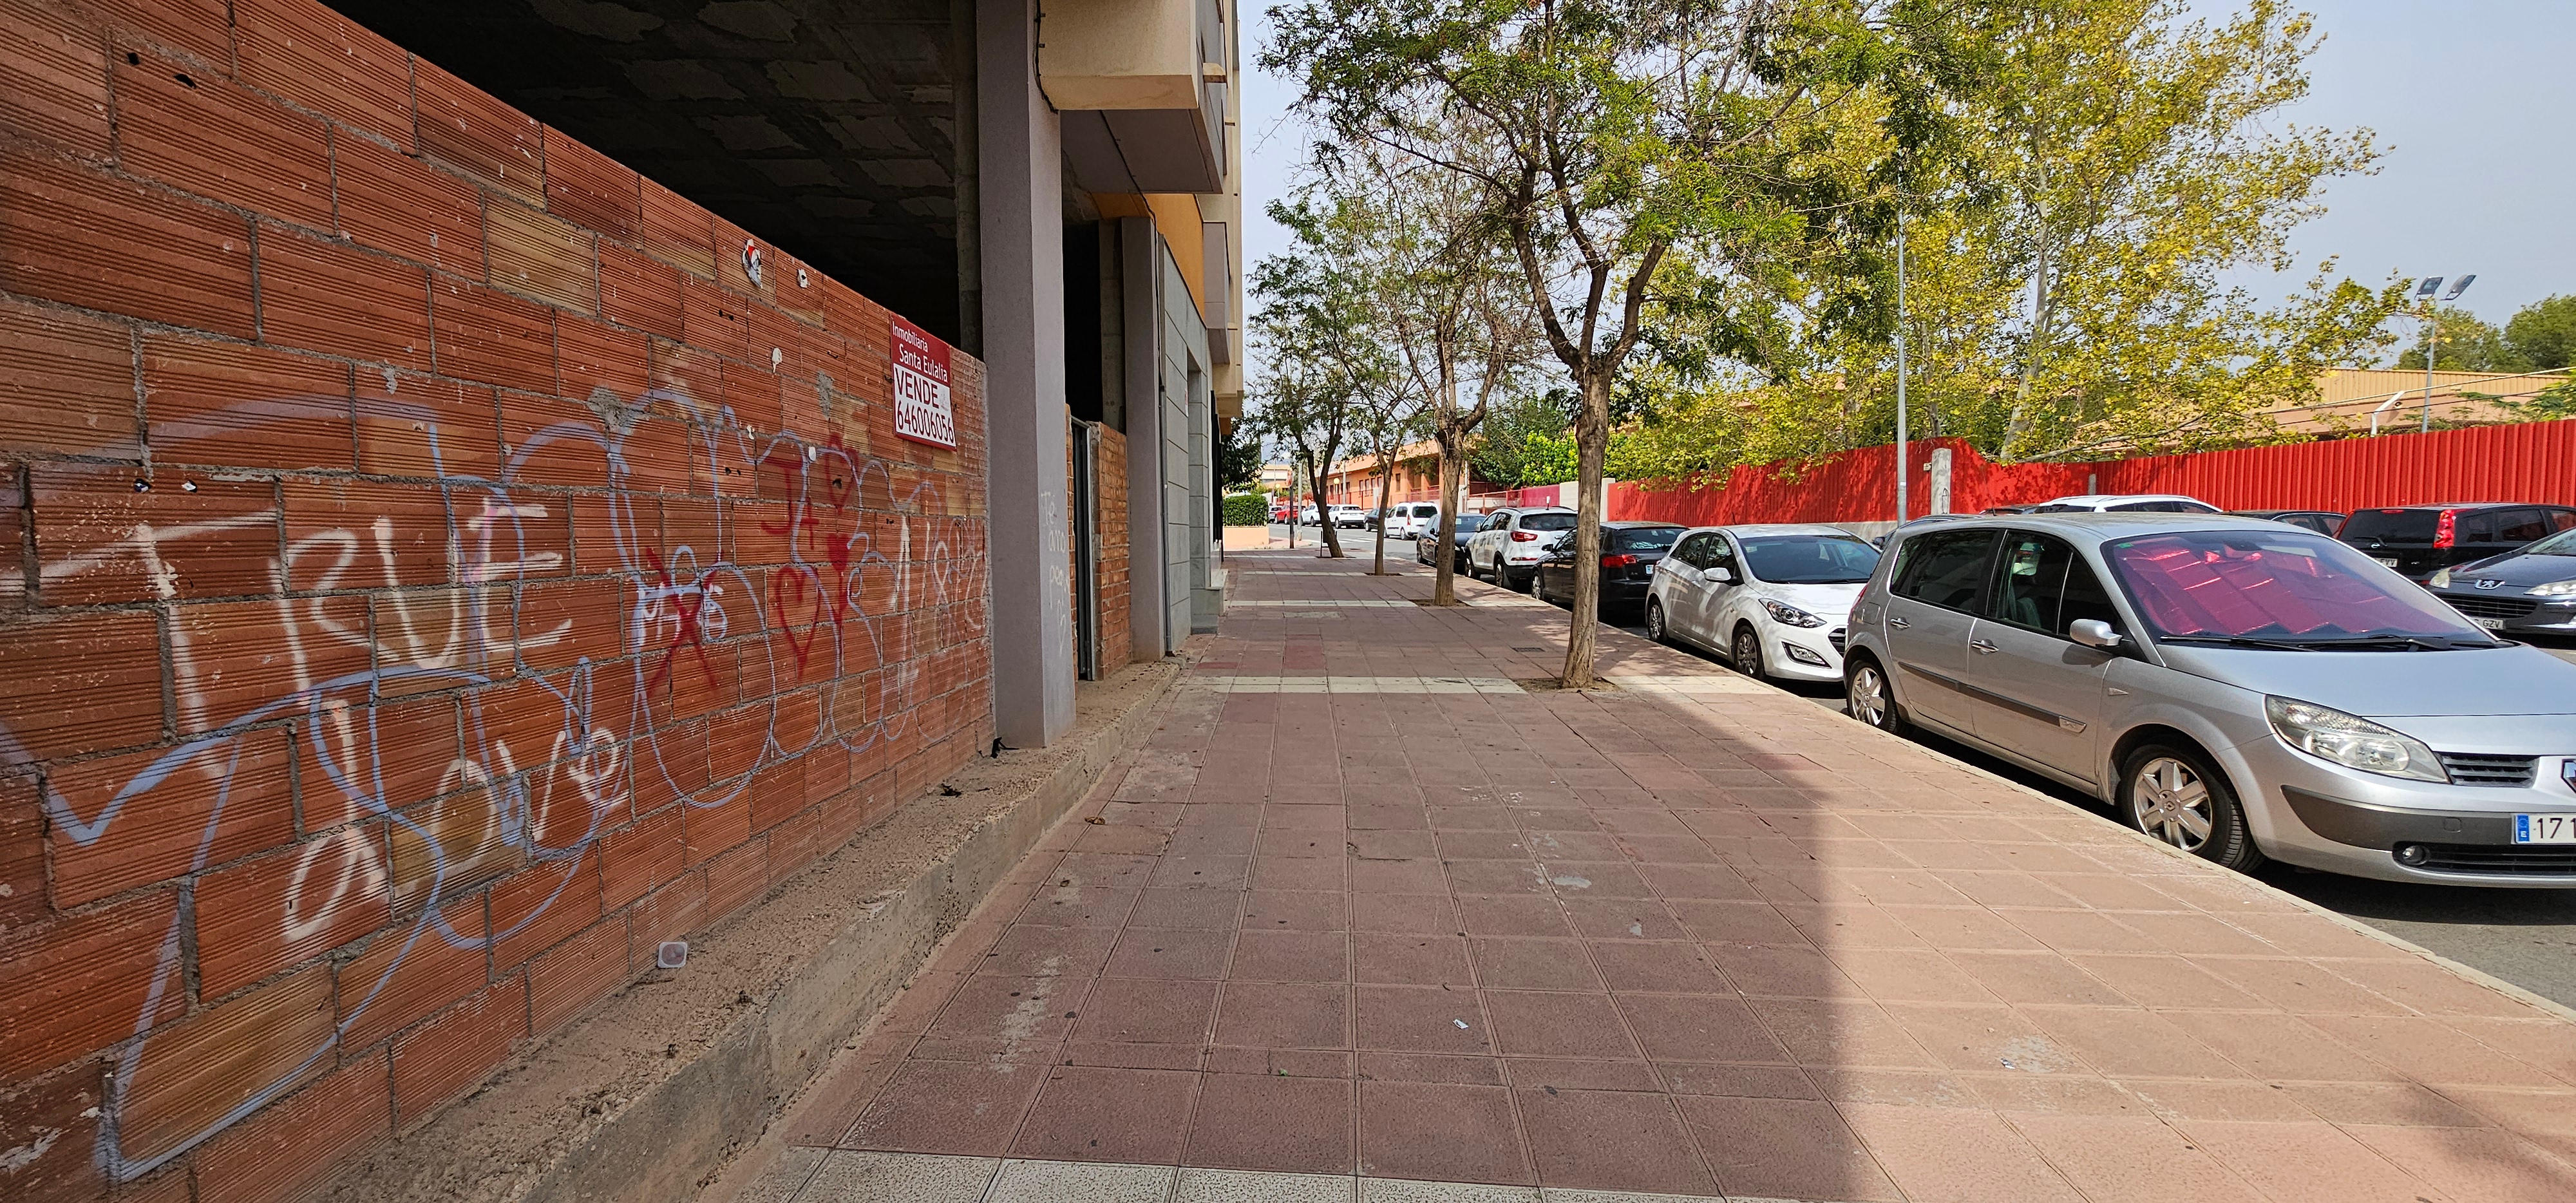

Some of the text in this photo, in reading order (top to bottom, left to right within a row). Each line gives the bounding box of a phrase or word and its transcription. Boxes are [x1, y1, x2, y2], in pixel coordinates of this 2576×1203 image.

[893, 321, 928, 352] Inmobiliaria
[899, 343, 948, 383] Santa Eulalia
[895, 367, 939, 408] VENDE
[897, 400, 953, 444] 646006056
[0, 497, 572, 786] TRUE
[2483, 620, 2500, 628] GZV
